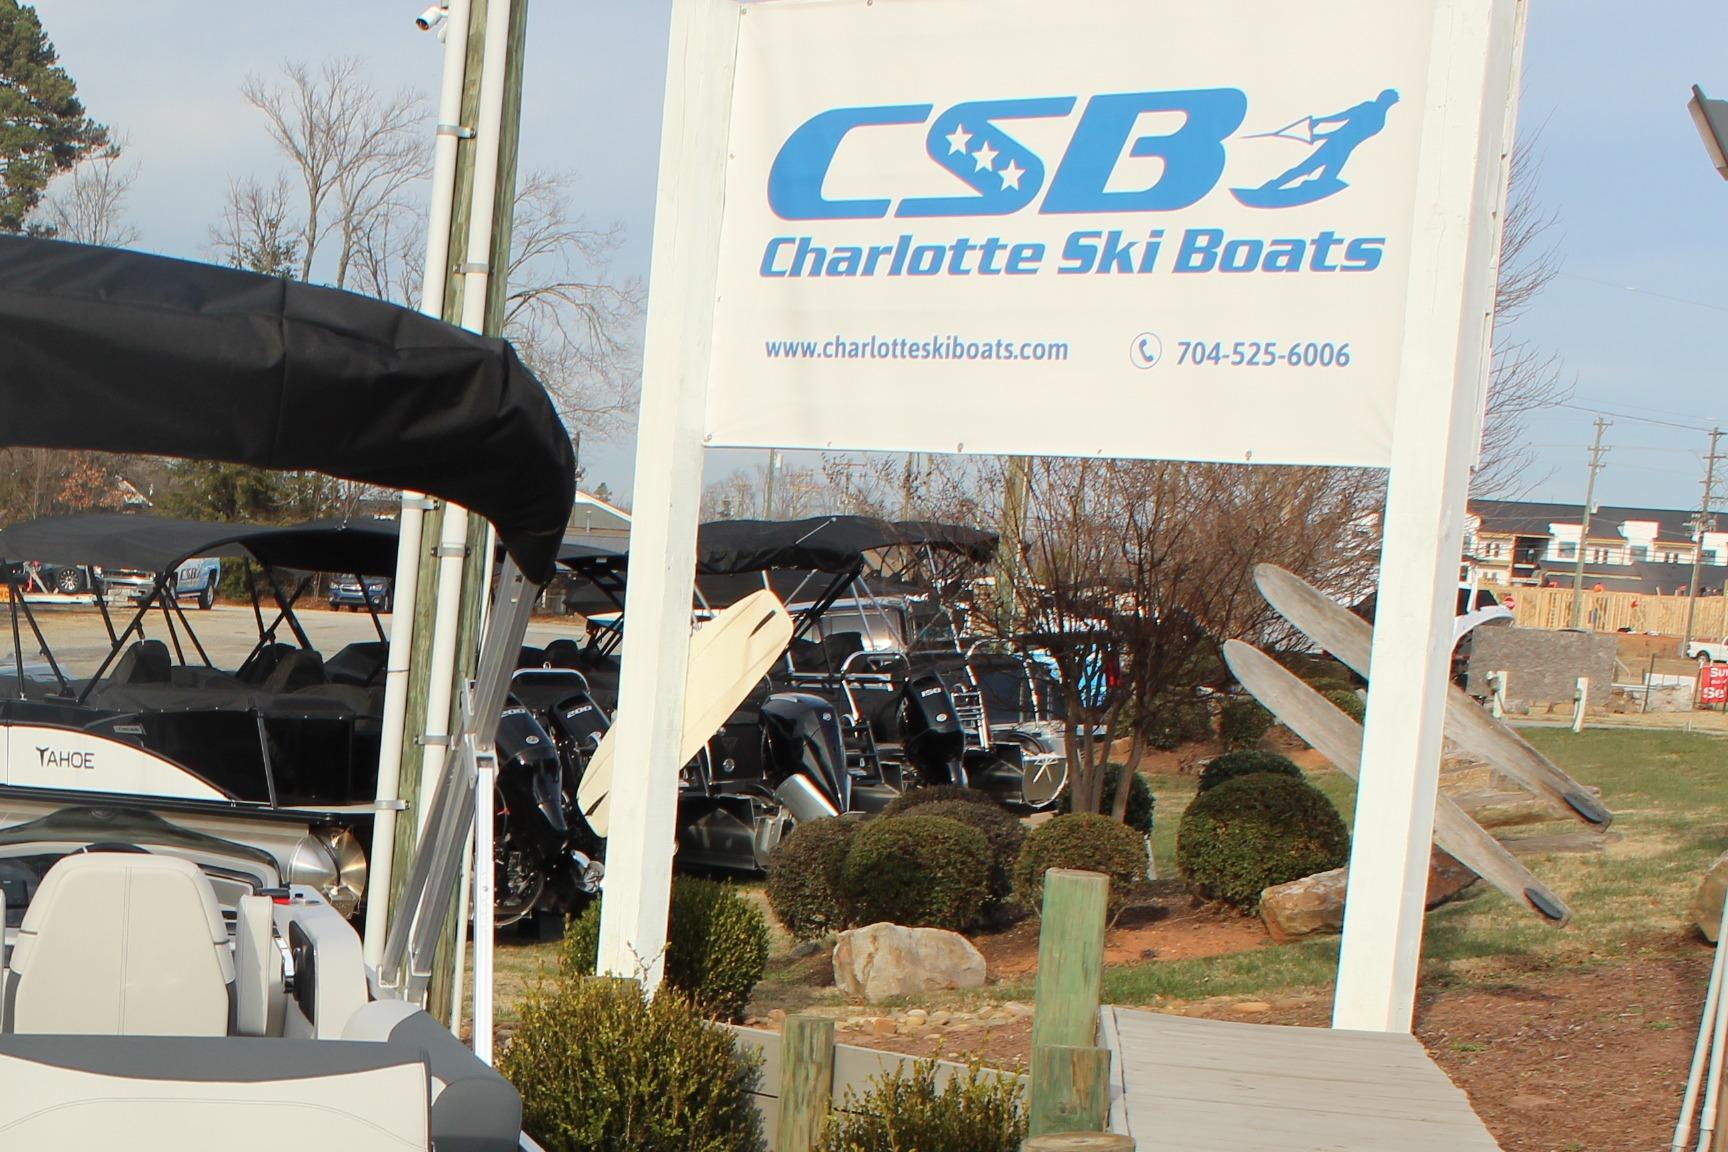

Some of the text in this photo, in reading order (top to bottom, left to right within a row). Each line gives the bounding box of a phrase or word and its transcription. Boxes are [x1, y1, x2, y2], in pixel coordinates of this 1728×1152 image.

[767, 87, 1247, 222] CSB
[759, 228, 1387, 279] Charlotte Ski Boats
[764, 333, 1070, 364] www.charlotteskiboats.com
[1176, 339, 1352, 368] 704-525-6006
[567, 705, 593, 719] 200
[35, 746, 96, 770] TAHOE
